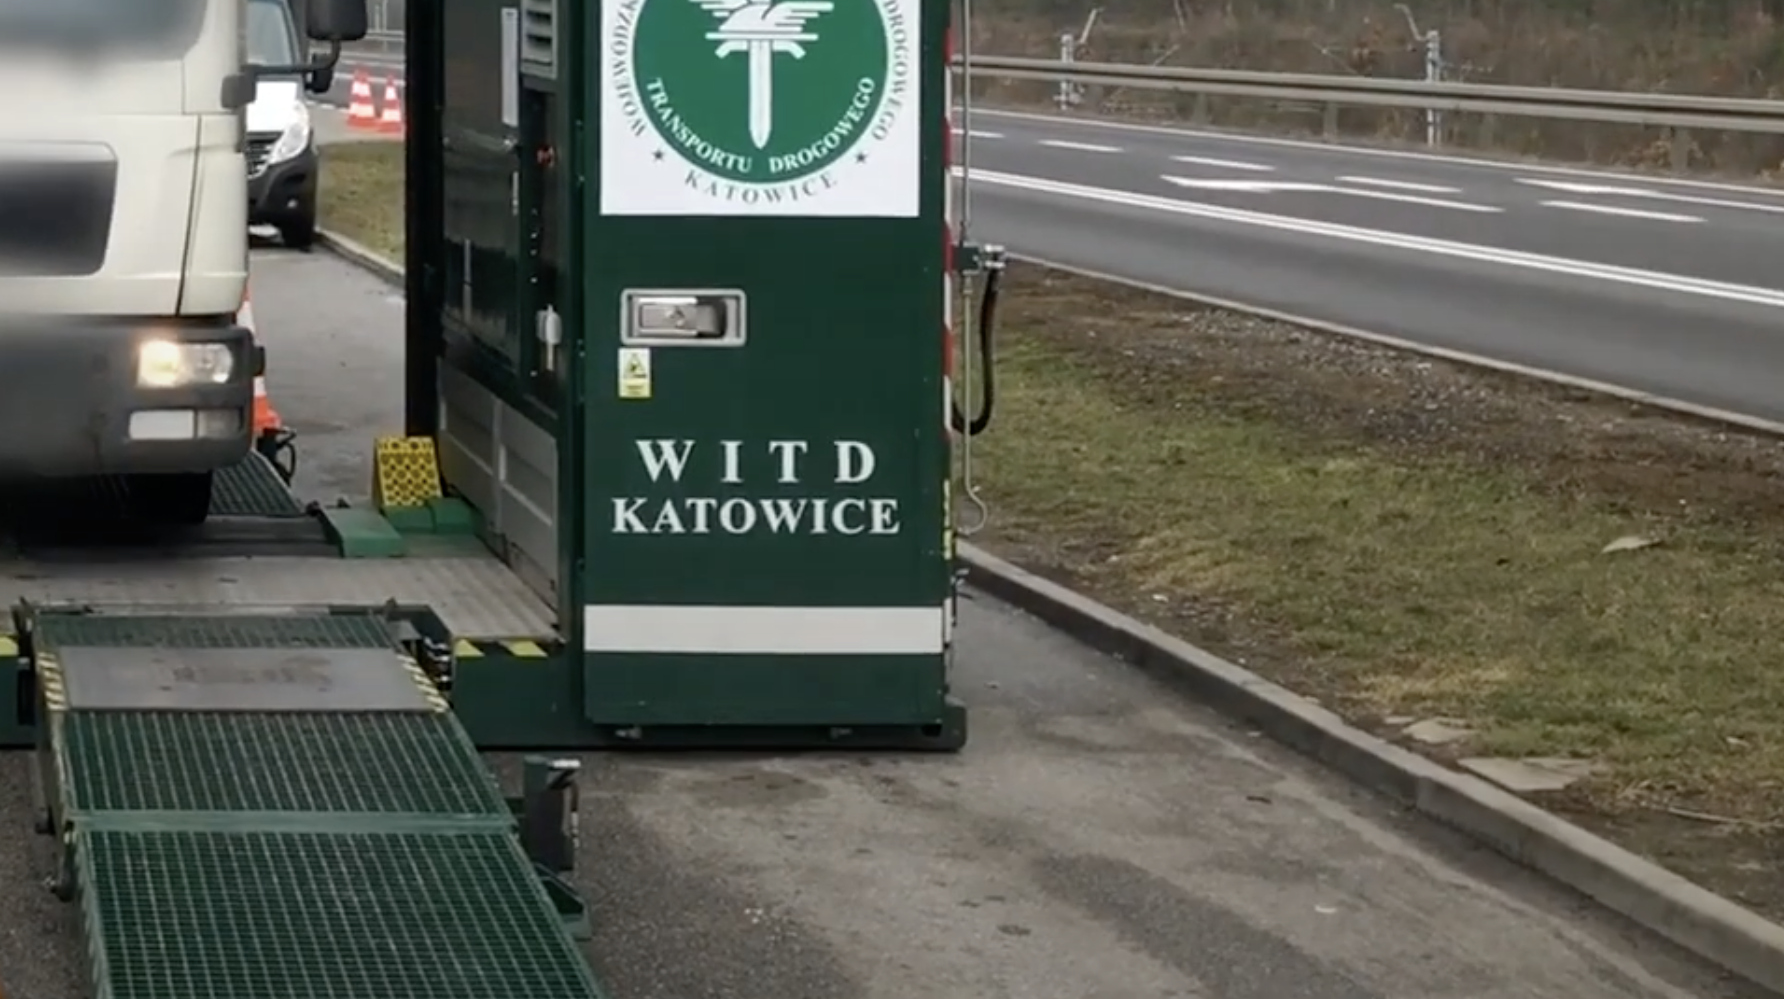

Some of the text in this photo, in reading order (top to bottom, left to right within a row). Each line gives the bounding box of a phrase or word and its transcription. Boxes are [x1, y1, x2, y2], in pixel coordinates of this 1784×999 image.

[872, 0, 908, 141] DROGOWEGO
[647, 76, 876, 173] TRANSPORTU DROGOWEGO
[684, 171, 838, 204] KATOWICE
[612, 498, 900, 534] KATOWICE
